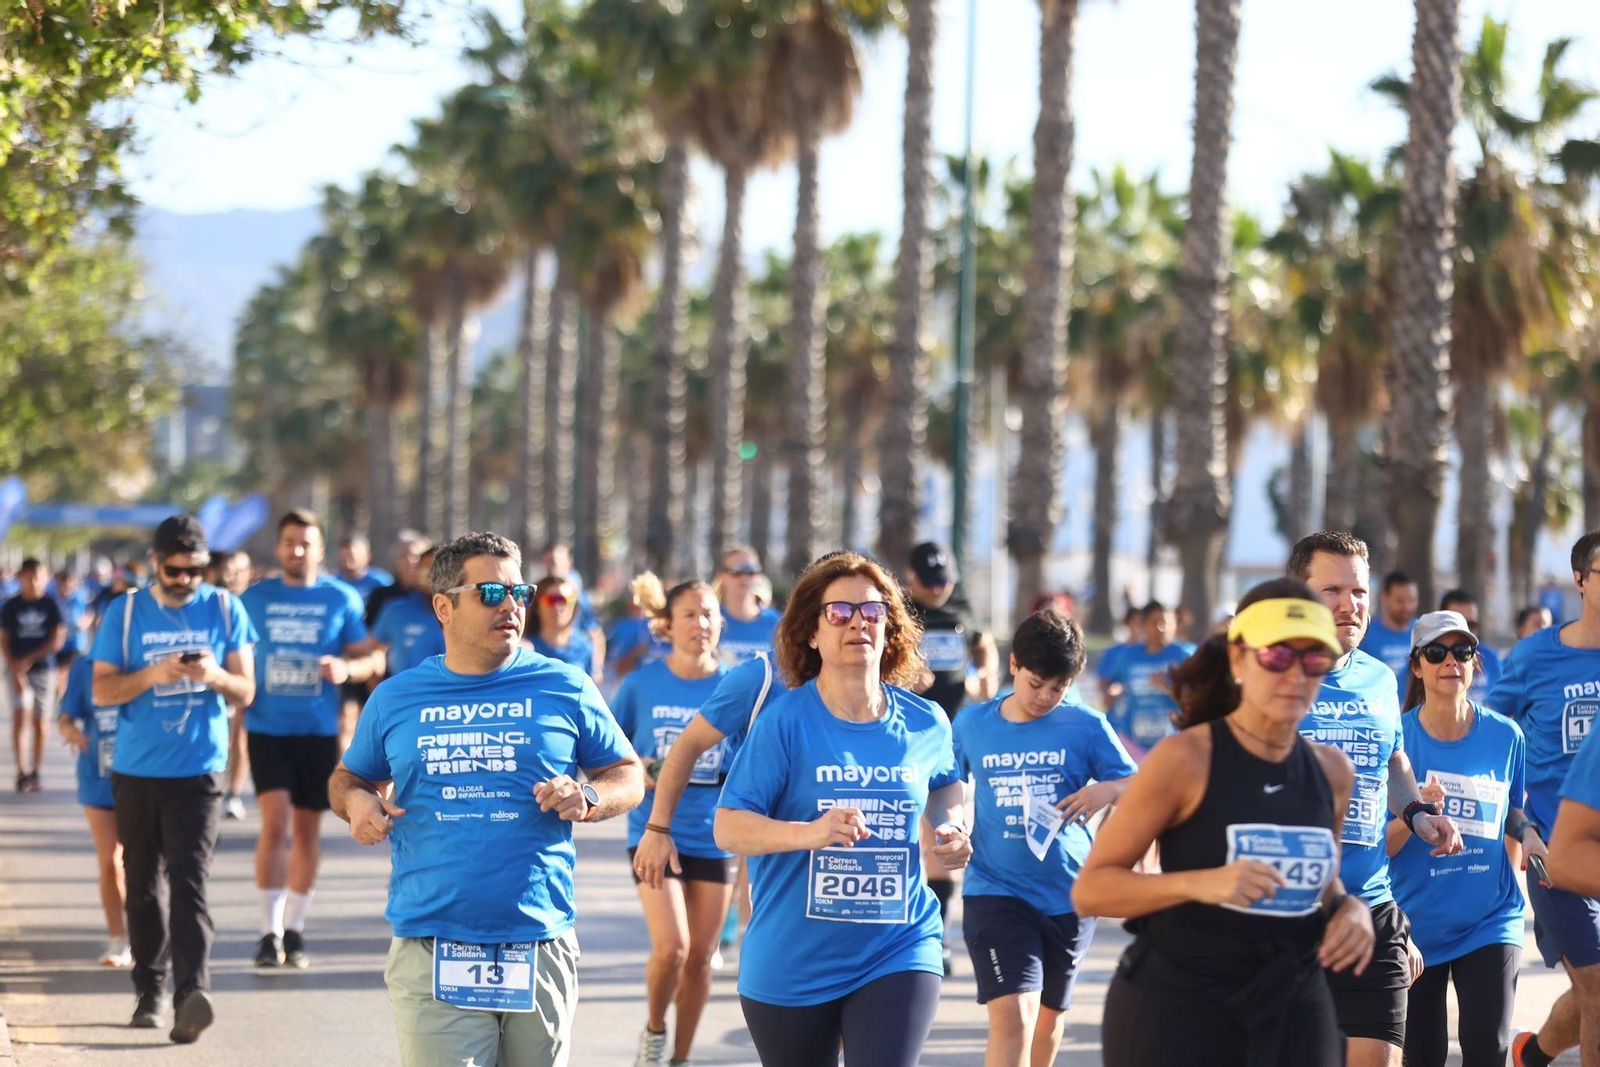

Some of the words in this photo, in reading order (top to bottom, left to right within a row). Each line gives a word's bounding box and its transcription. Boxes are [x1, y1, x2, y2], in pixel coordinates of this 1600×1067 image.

[141, 628, 210, 646] mayoral
[420, 698, 532, 725] mayoral
[417, 732, 525, 748] RUNNING
[427, 745, 515, 761] MAKES
[982, 748, 1066, 770] mayoral
[426, 759, 517, 775] FRIENDS
[816, 762, 919, 788] mayoral
[458, 791, 495, 799] INFANTILES
[828, 856, 857, 864] Carrera
[875, 853, 904, 862] mayoral
[828, 863, 862, 871] Solidaria
[822, 875, 896, 897] 2046
[467, 964, 504, 985] 13
